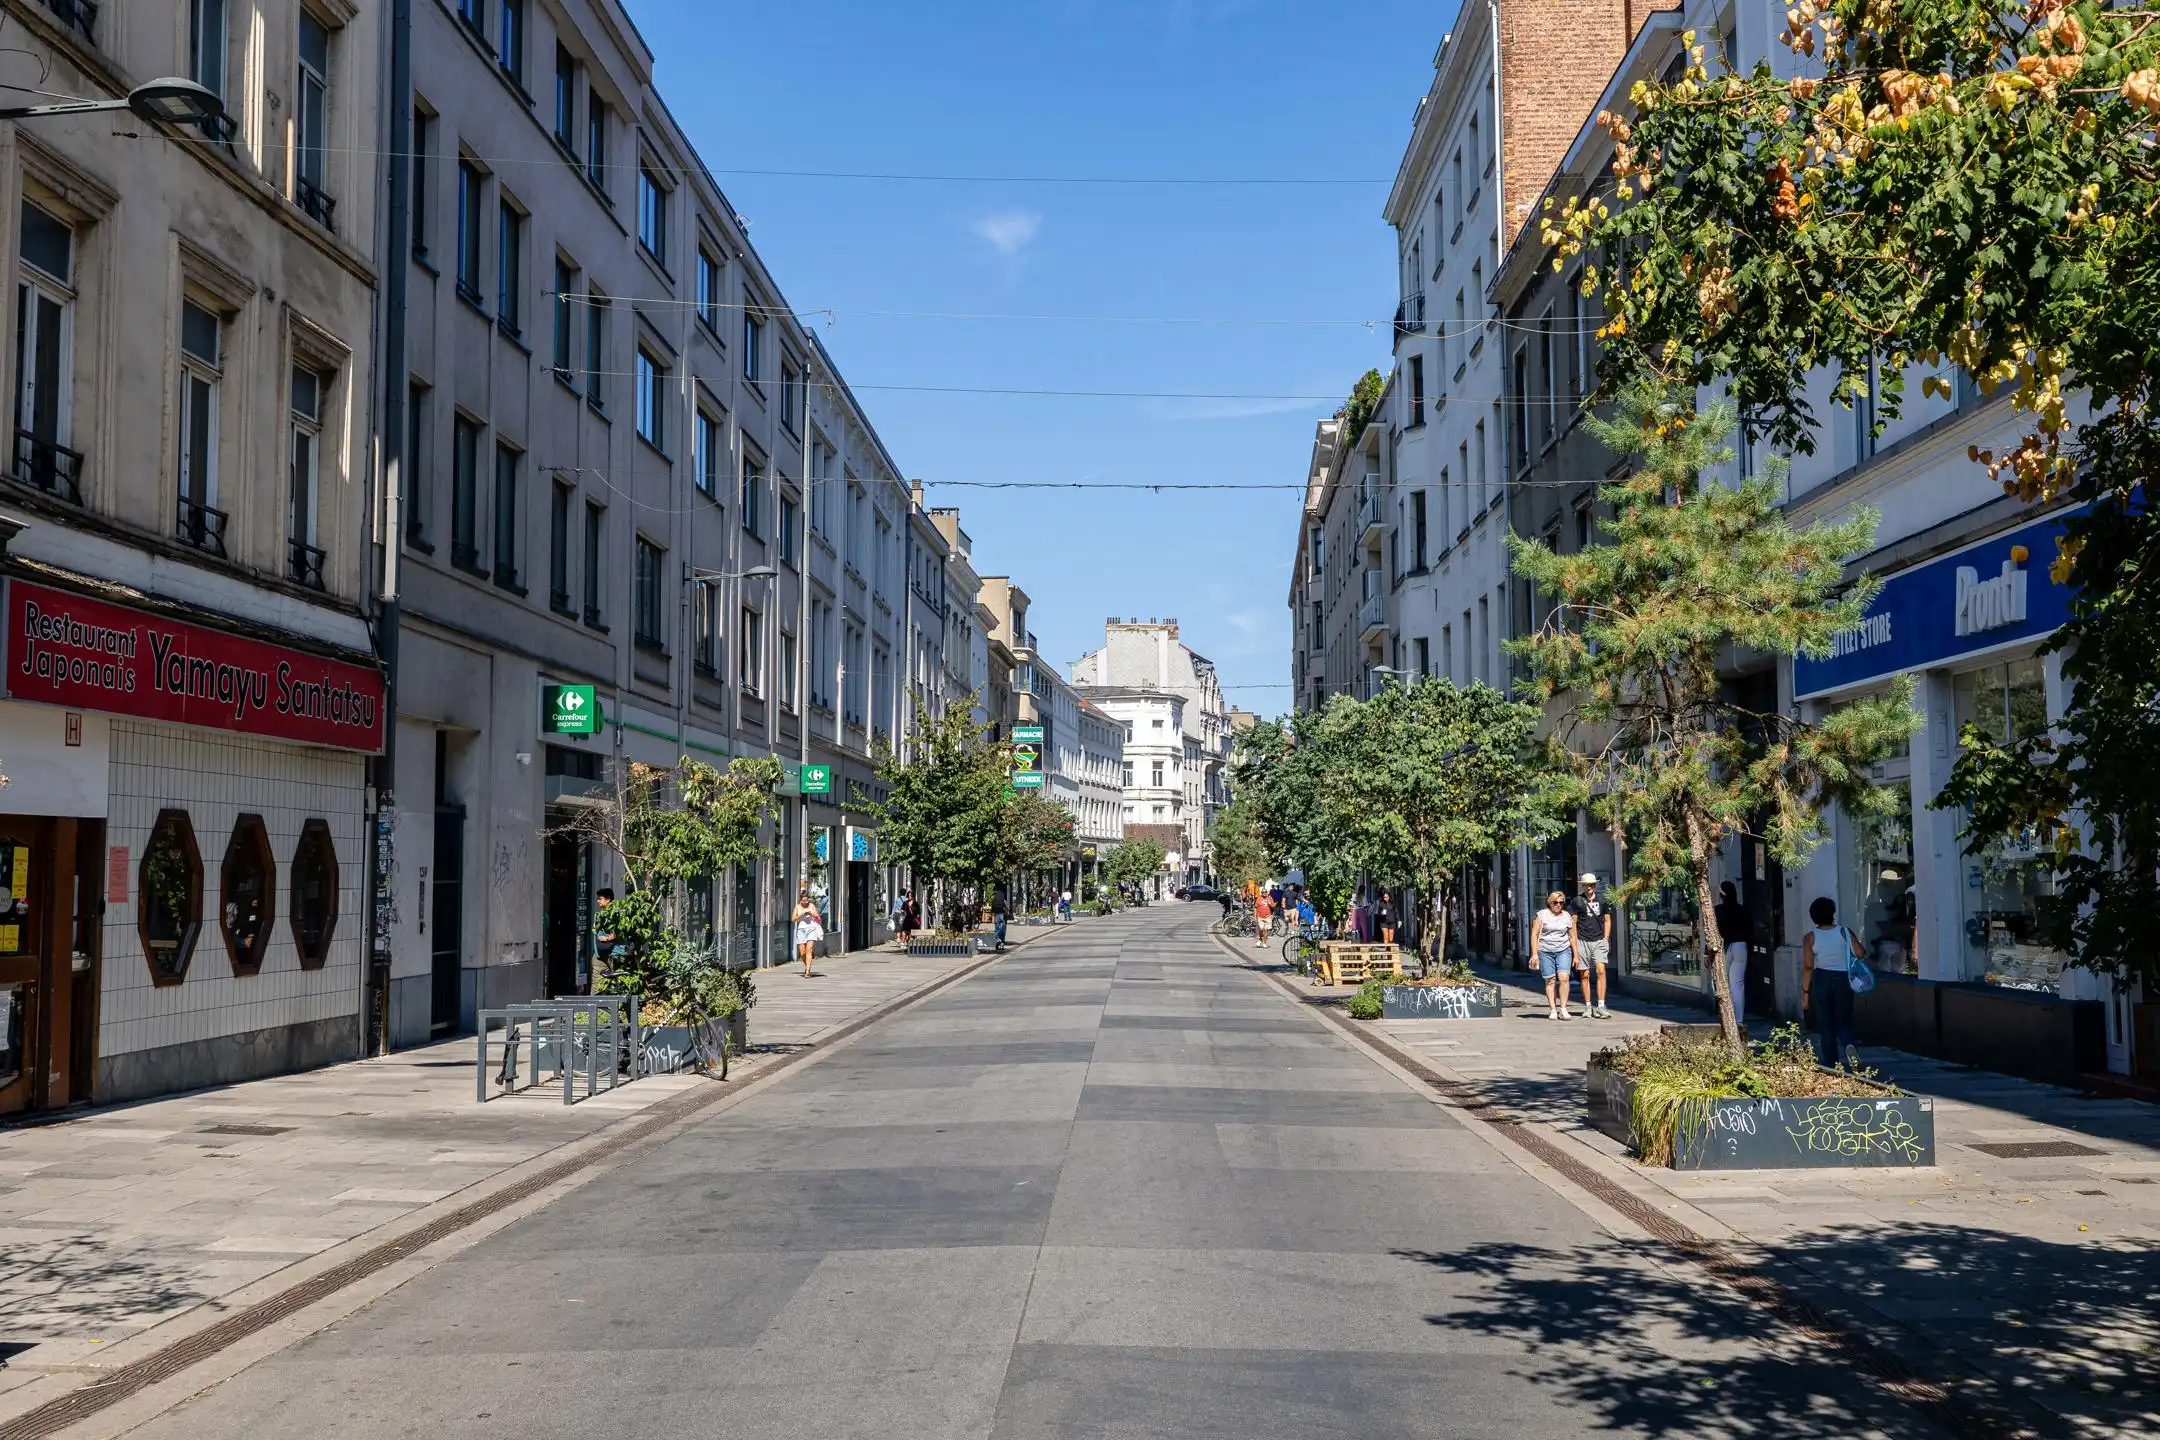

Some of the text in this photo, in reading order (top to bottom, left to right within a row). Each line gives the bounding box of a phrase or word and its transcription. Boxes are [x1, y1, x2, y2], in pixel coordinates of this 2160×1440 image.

[1954, 545, 2029, 637] Pronti
[24, 601, 137, 658] Restaurant
[1861, 612, 1892, 650] STORE
[21, 639, 136, 693] Japonais
[148, 631, 376, 729] Yamayu Santatsu
